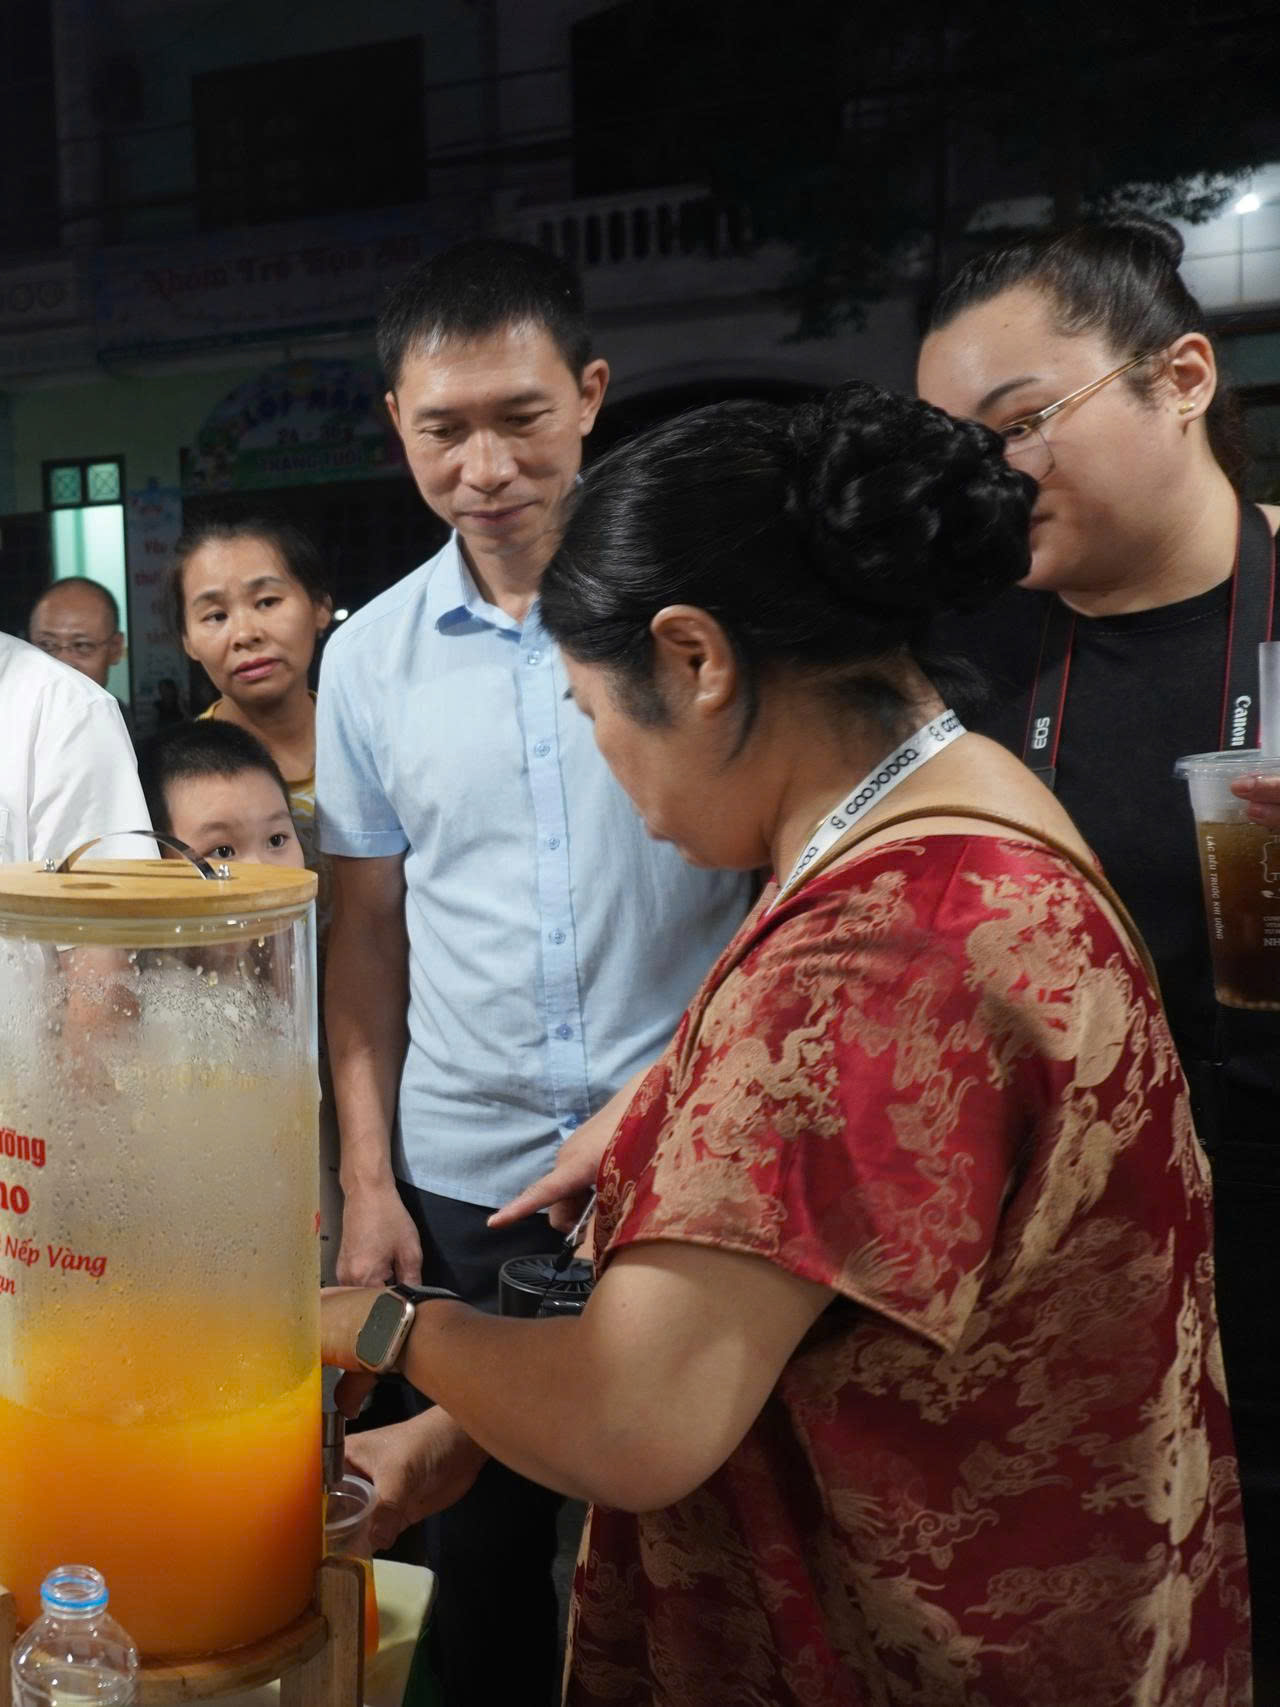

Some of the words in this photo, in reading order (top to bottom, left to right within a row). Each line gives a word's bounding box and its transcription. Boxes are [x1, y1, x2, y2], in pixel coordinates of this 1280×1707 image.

[1032, 716, 1051, 750] EOS
[1230, 695, 1252, 747] Canon
[5, 1235, 40, 1267] Nếp
[47, 1244, 108, 1278] Vàng
